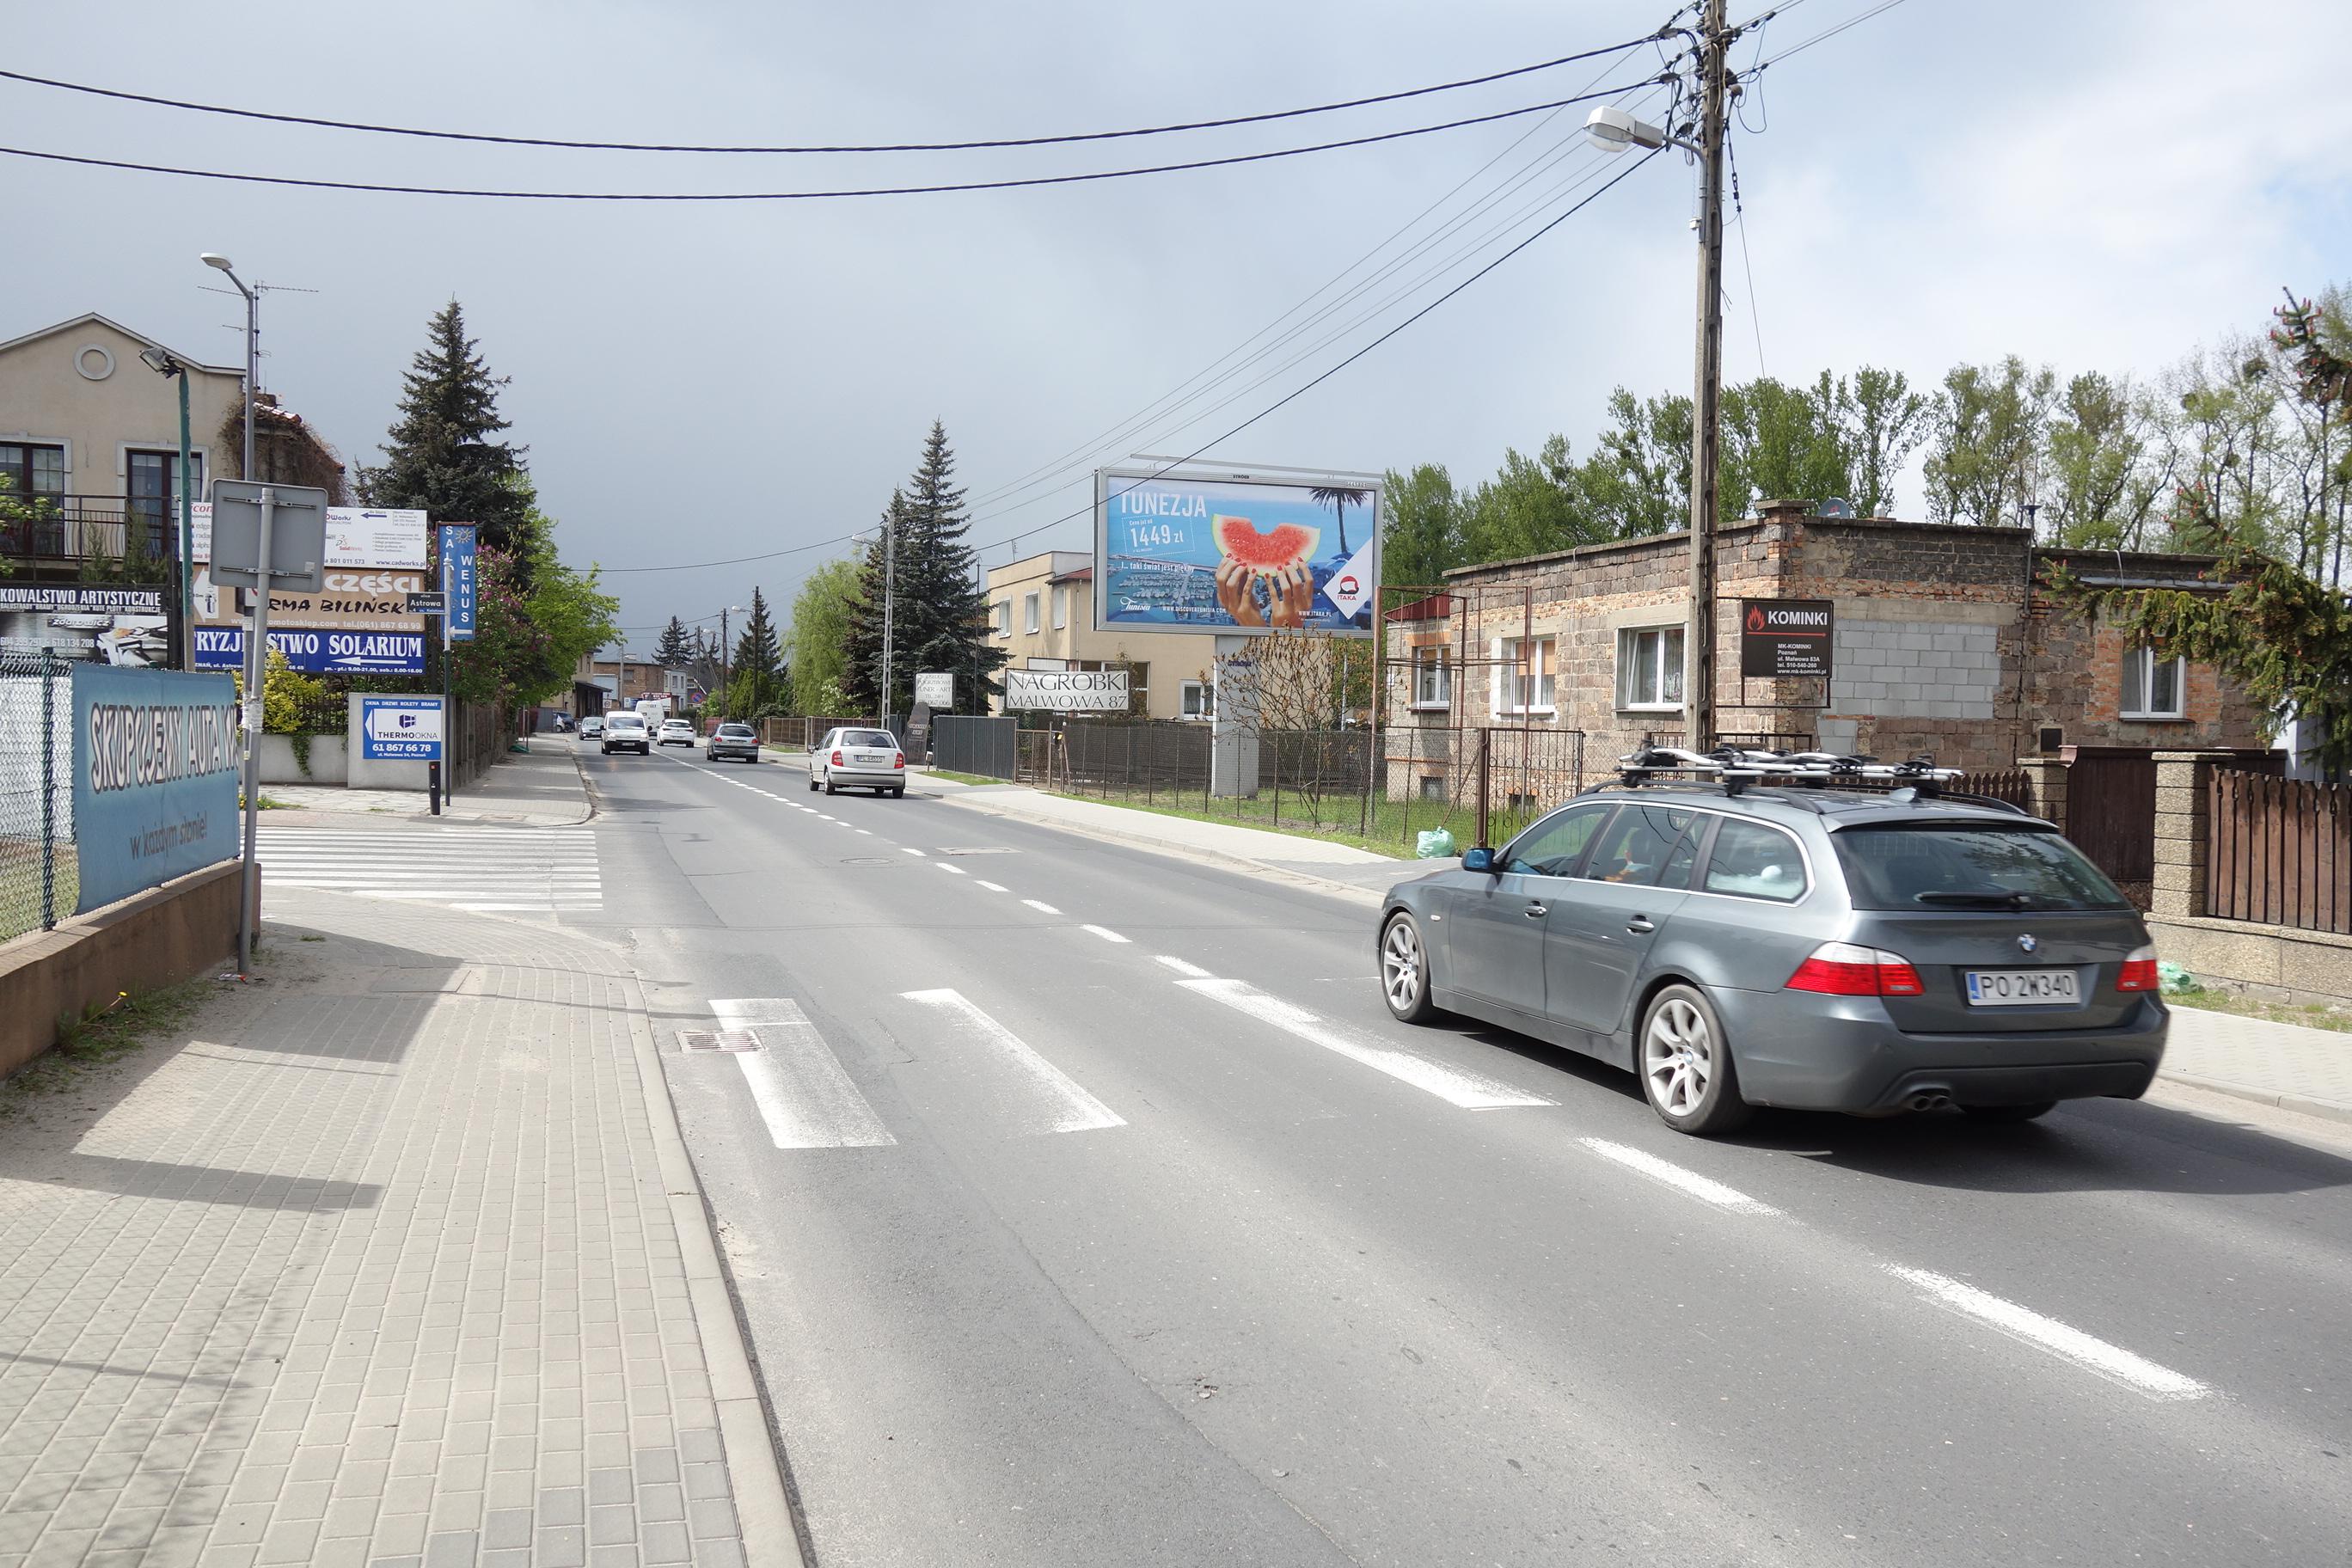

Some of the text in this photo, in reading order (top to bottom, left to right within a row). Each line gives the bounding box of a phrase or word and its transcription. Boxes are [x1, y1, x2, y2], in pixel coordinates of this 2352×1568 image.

[1120, 491, 1207, 518] TUNEZJA
[1130, 524, 1184, 548] 1449 zł
[1143, 561, 1160, 571] świat
[324, 571, 420, 597] CZĘŚCI
[460, 555, 473, 622] WENUS
[0, 588, 162, 606] KOWALSTWO ARTYSTYCZNE
[1767, 610, 1828, 626] KOMINKI
[328, 634, 422, 657] SOLARIUM
[1008, 673, 1127, 691] NAGROBKI
[1008, 695, 1127, 708] MALWOWA 87
[90, 701, 183, 795] SKUPUJEMY
[187, 704, 223, 778] AUTA
[406, 744, 418, 752] 66
[142, 821, 178, 857] każdym
[179, 810, 207, 846] stanie!
[1981, 976, 2011, 998] PO
